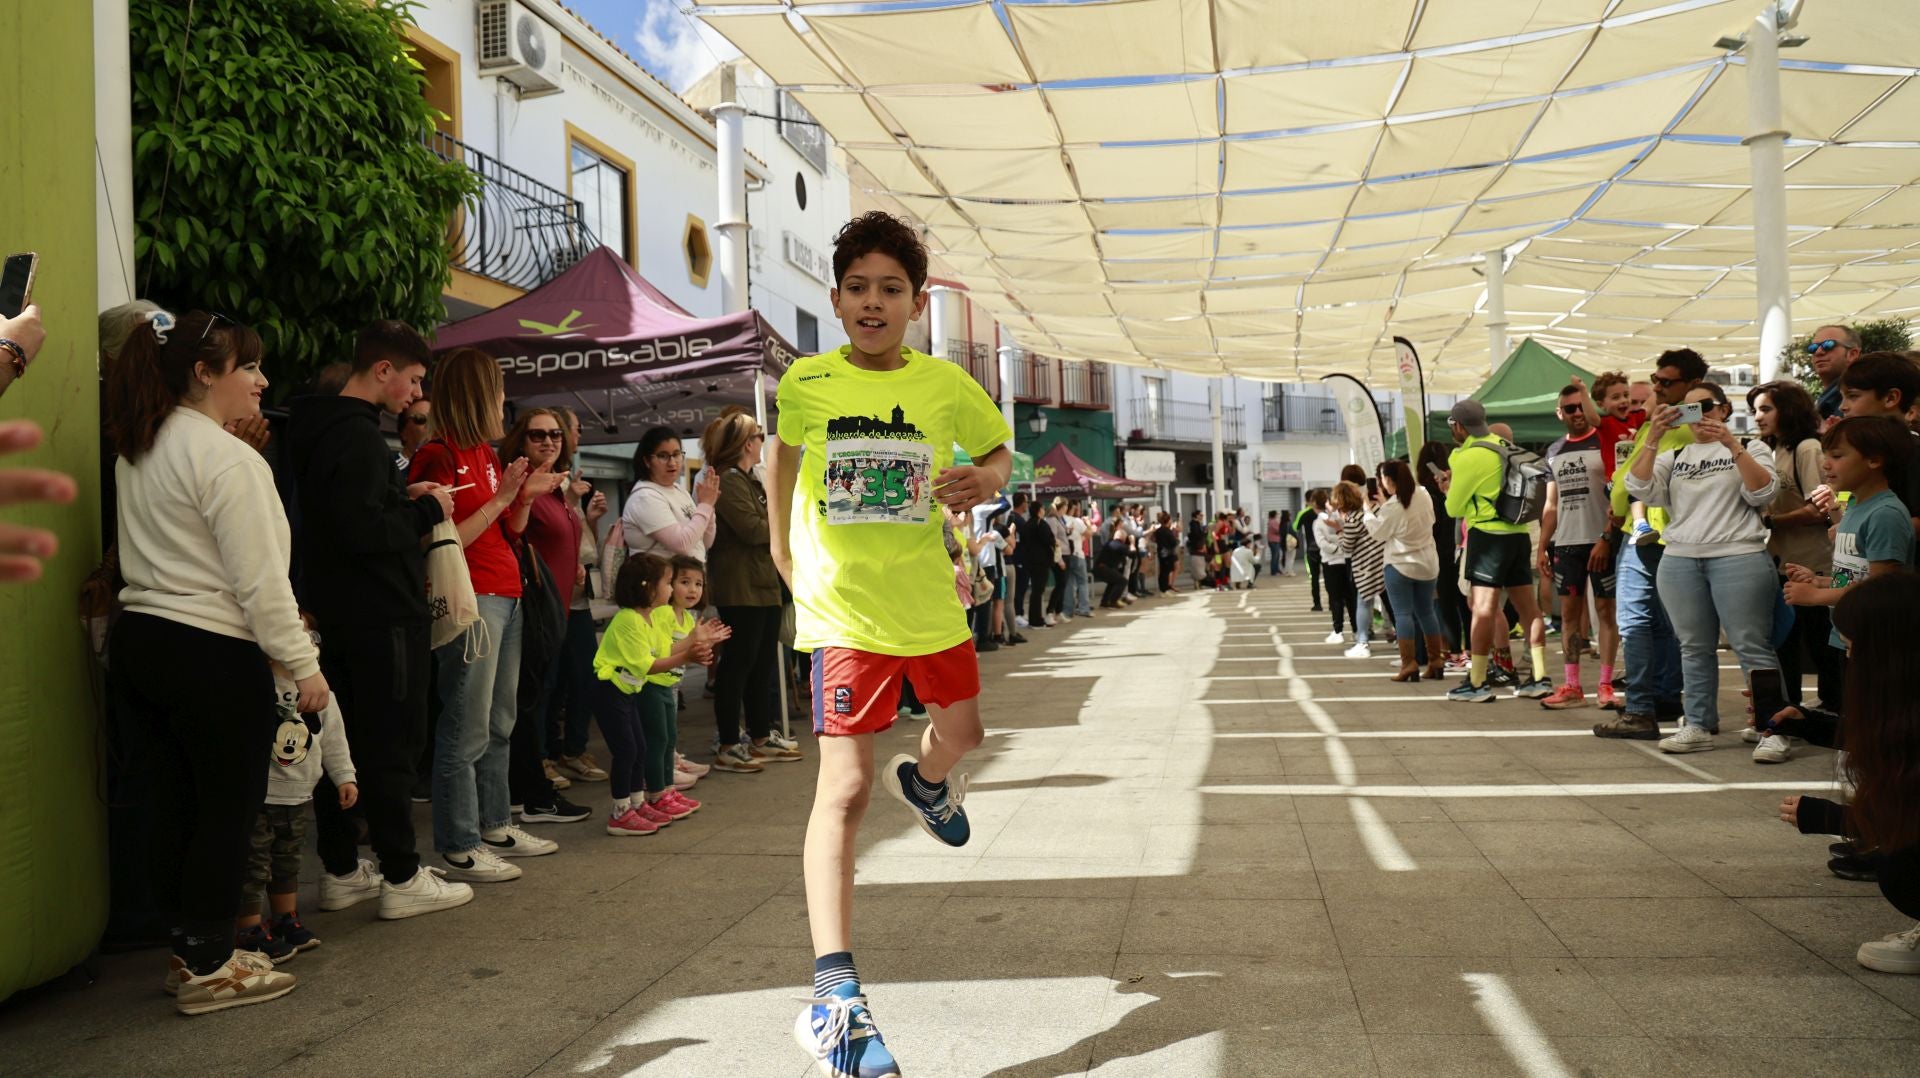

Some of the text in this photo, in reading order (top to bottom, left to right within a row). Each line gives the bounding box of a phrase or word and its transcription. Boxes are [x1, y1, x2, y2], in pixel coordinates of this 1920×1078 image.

[496, 335, 714, 377] esponsable
[827, 429, 866, 441] Valverde
[868, 428, 881, 440] de
[1558, 465, 1587, 477] CROSS
[860, 467, 907, 506] 35
